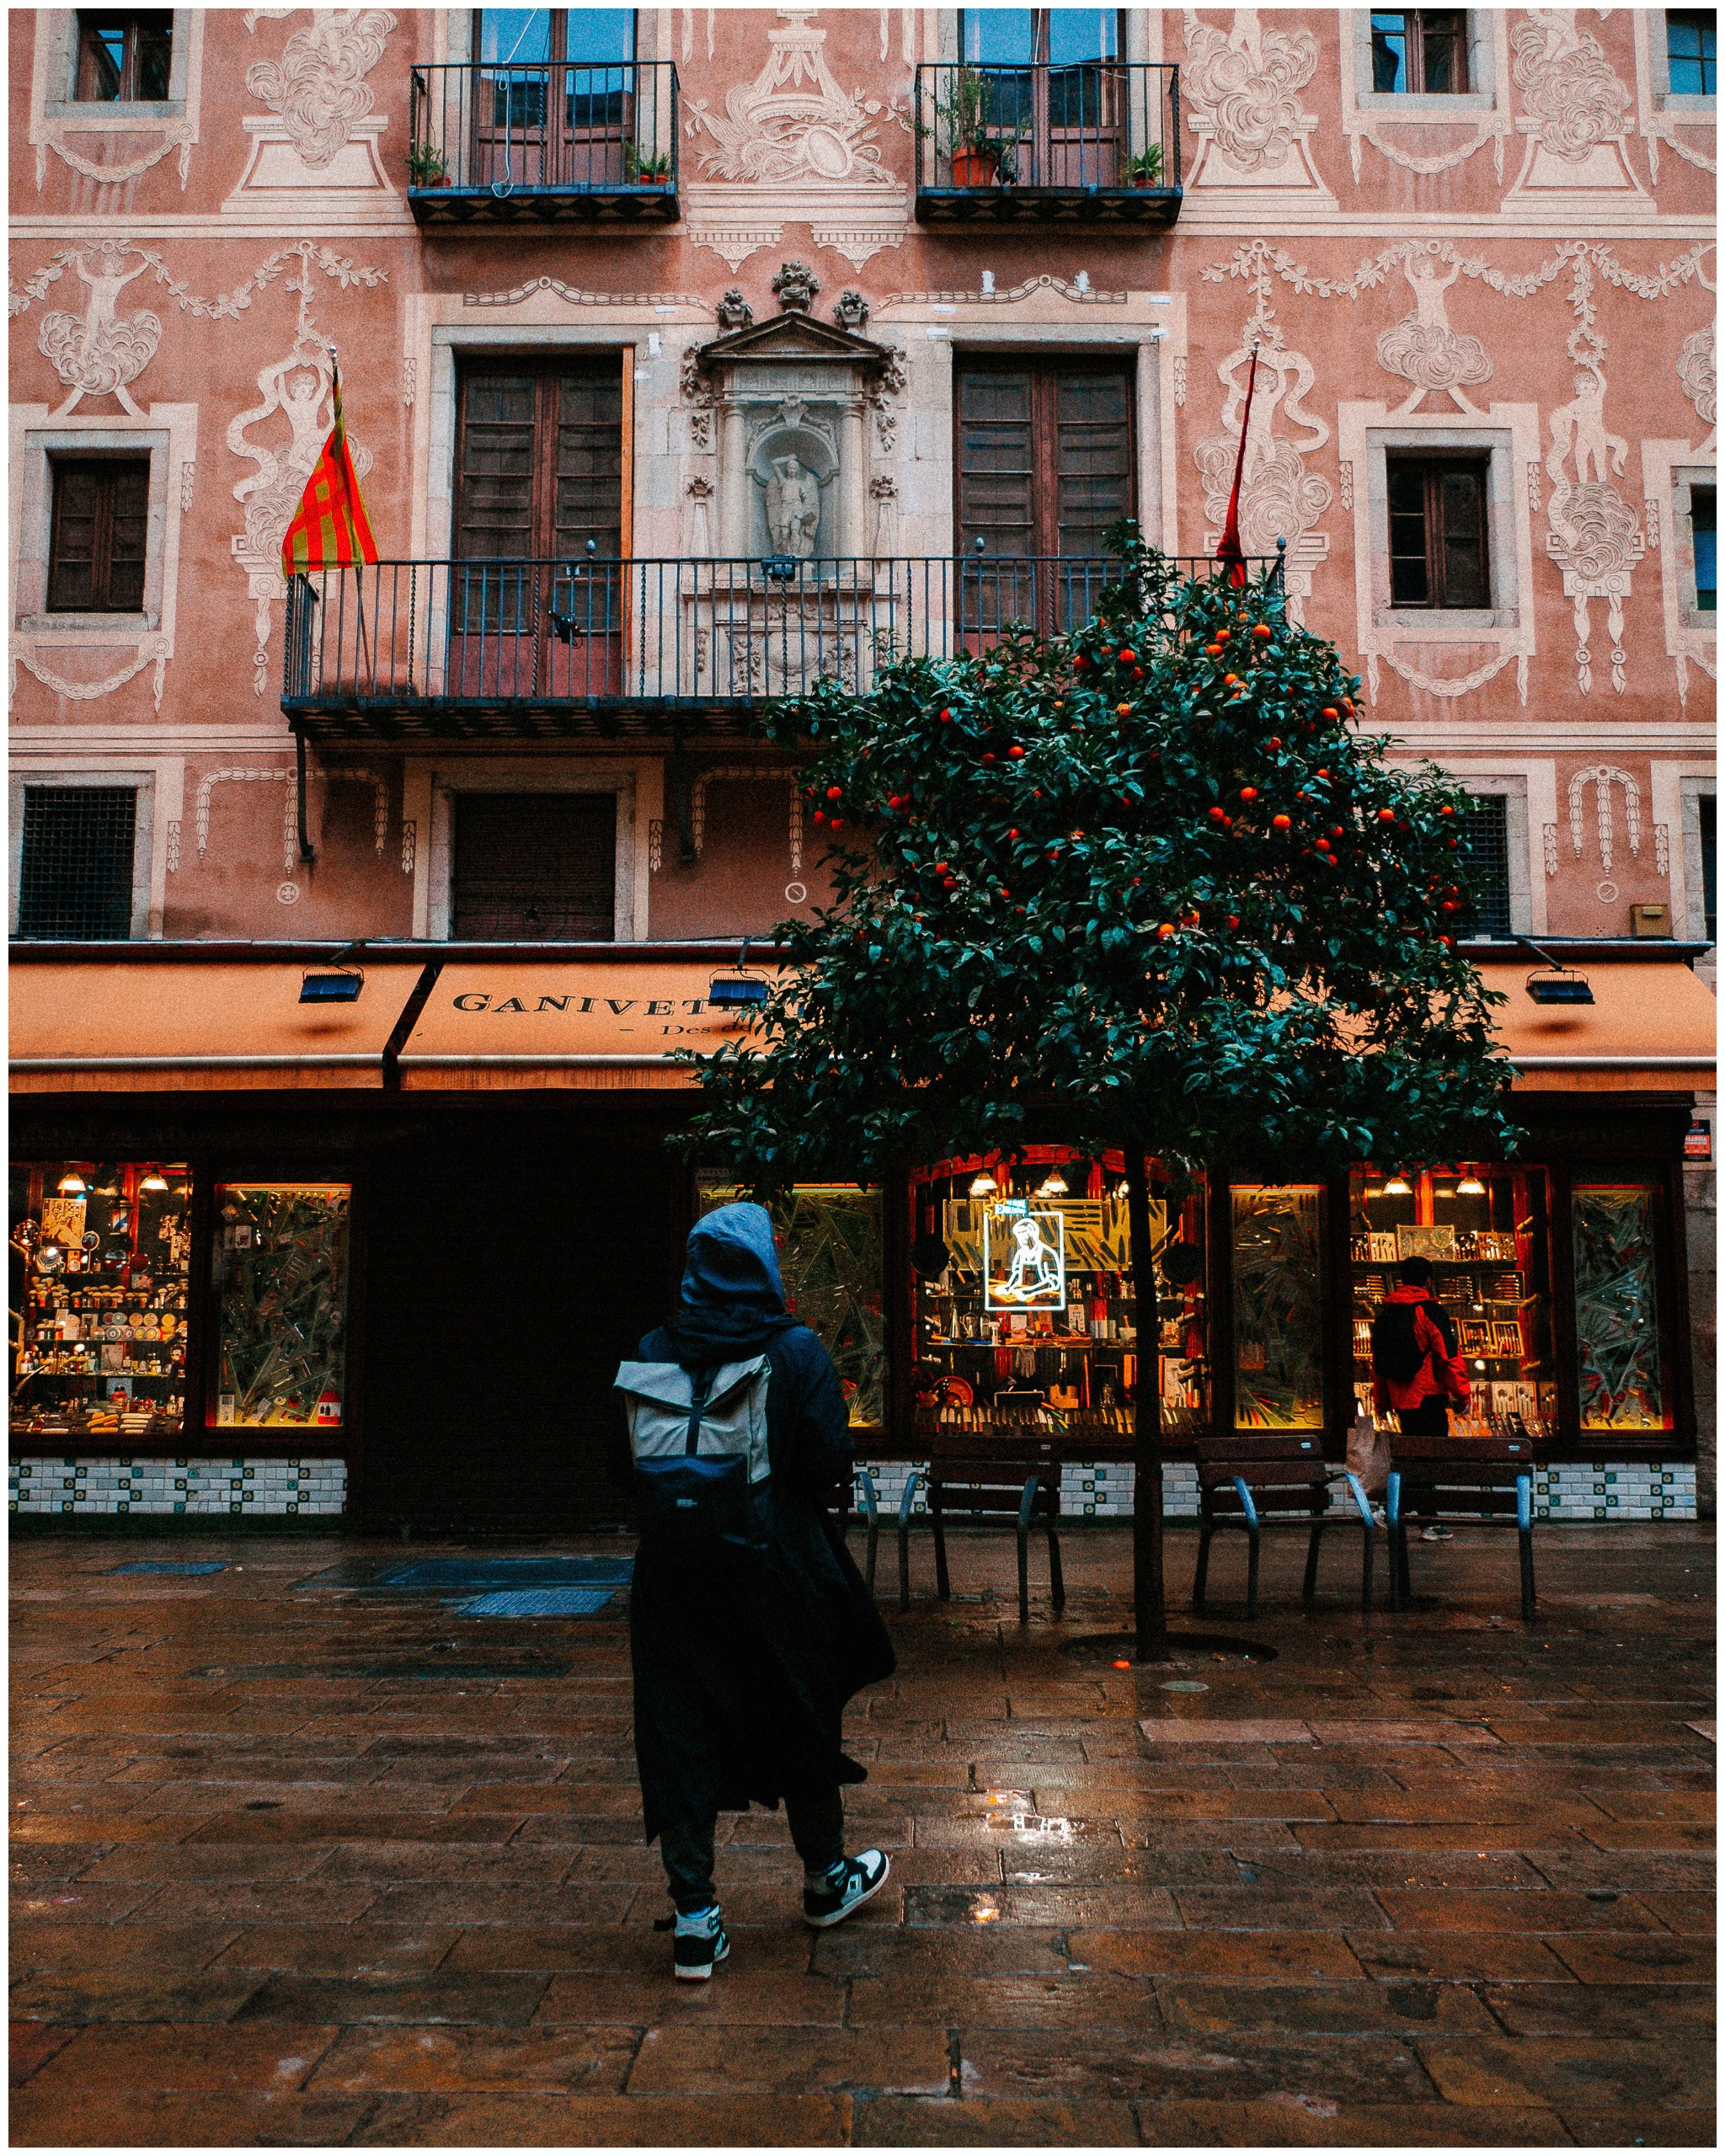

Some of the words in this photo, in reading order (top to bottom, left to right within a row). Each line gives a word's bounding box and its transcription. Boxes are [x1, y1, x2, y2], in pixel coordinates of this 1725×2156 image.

[1231, 350, 1297, 367] ANELUS
[452, 993, 745, 1016] GANIVET
[660, 1025, 711, 1035] Des
